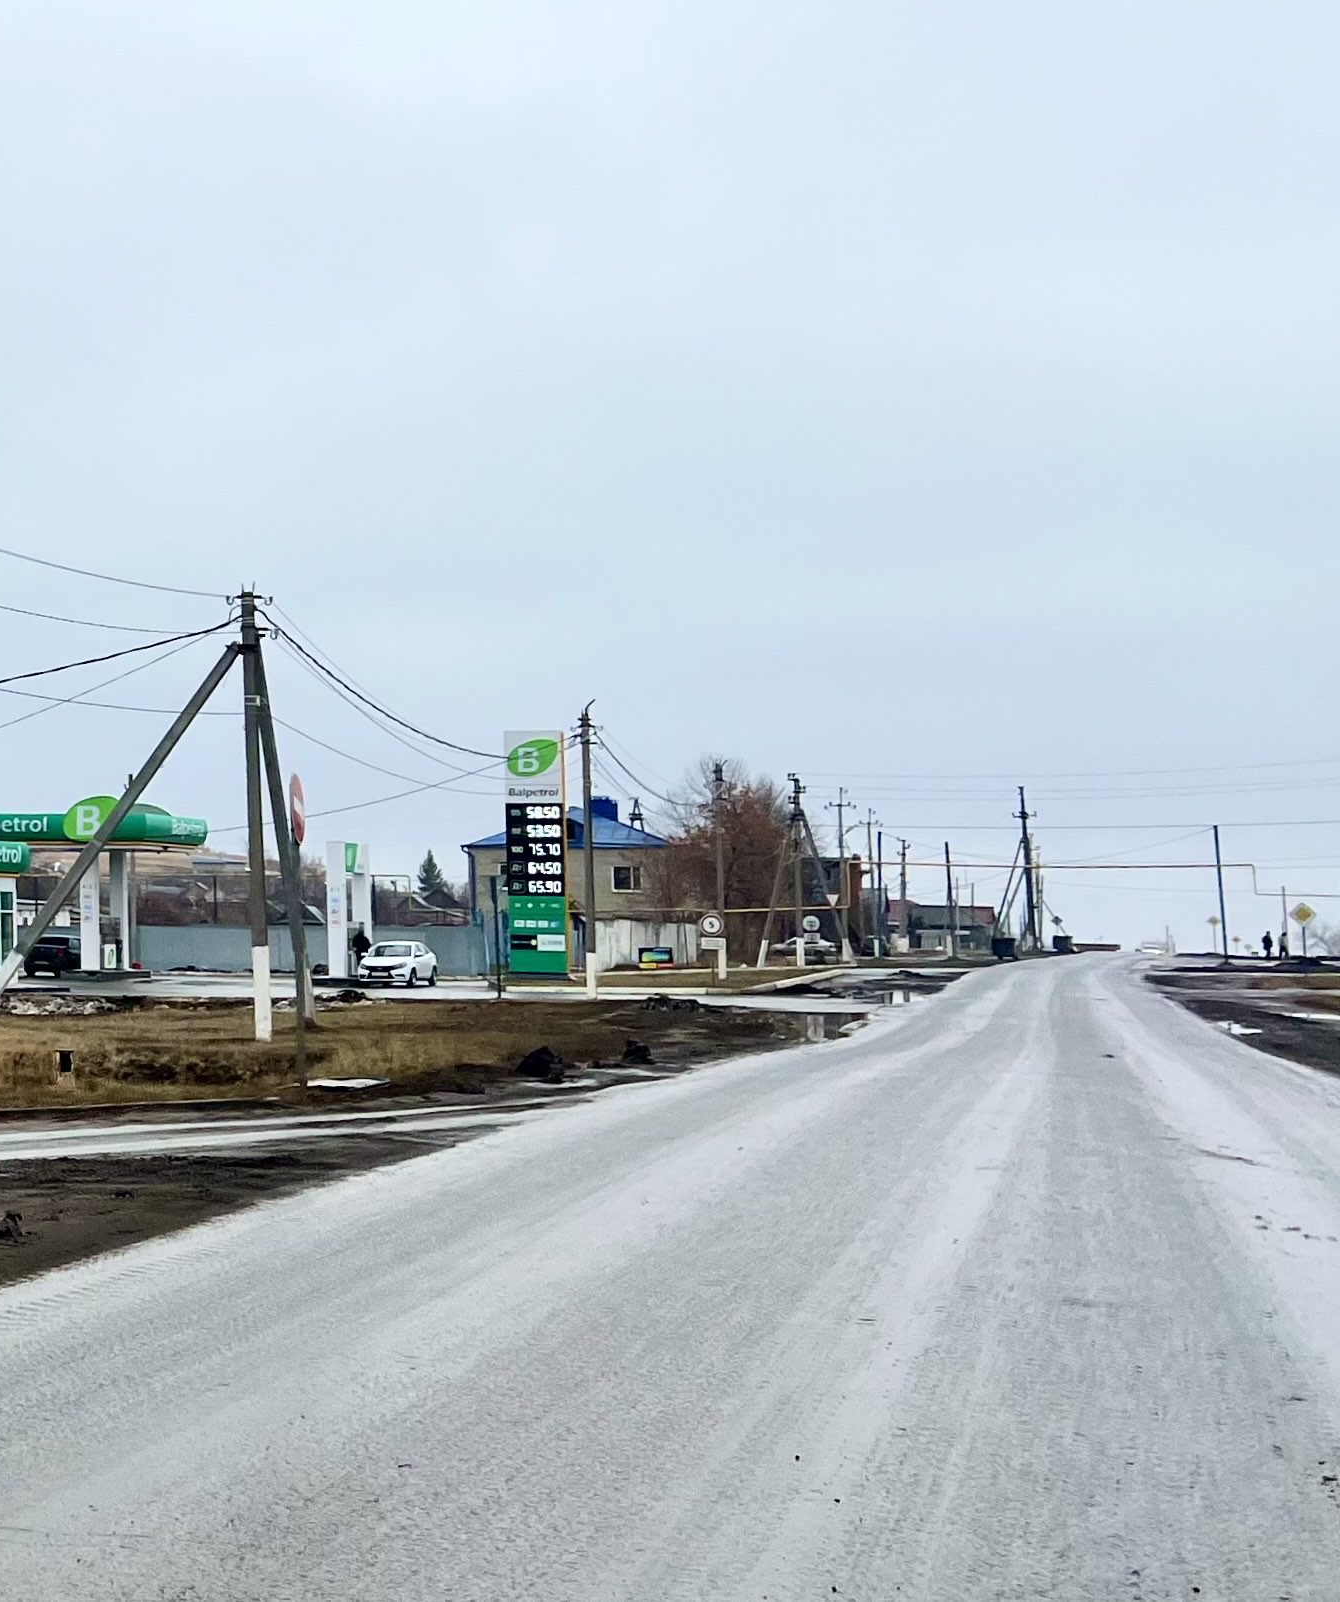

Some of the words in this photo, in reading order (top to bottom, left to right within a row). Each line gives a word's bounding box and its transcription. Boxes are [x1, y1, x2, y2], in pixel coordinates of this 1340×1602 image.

[517, 747, 540, 773] B
[508, 787, 559, 799] Balpetrol
[76, 805, 102, 836] B
